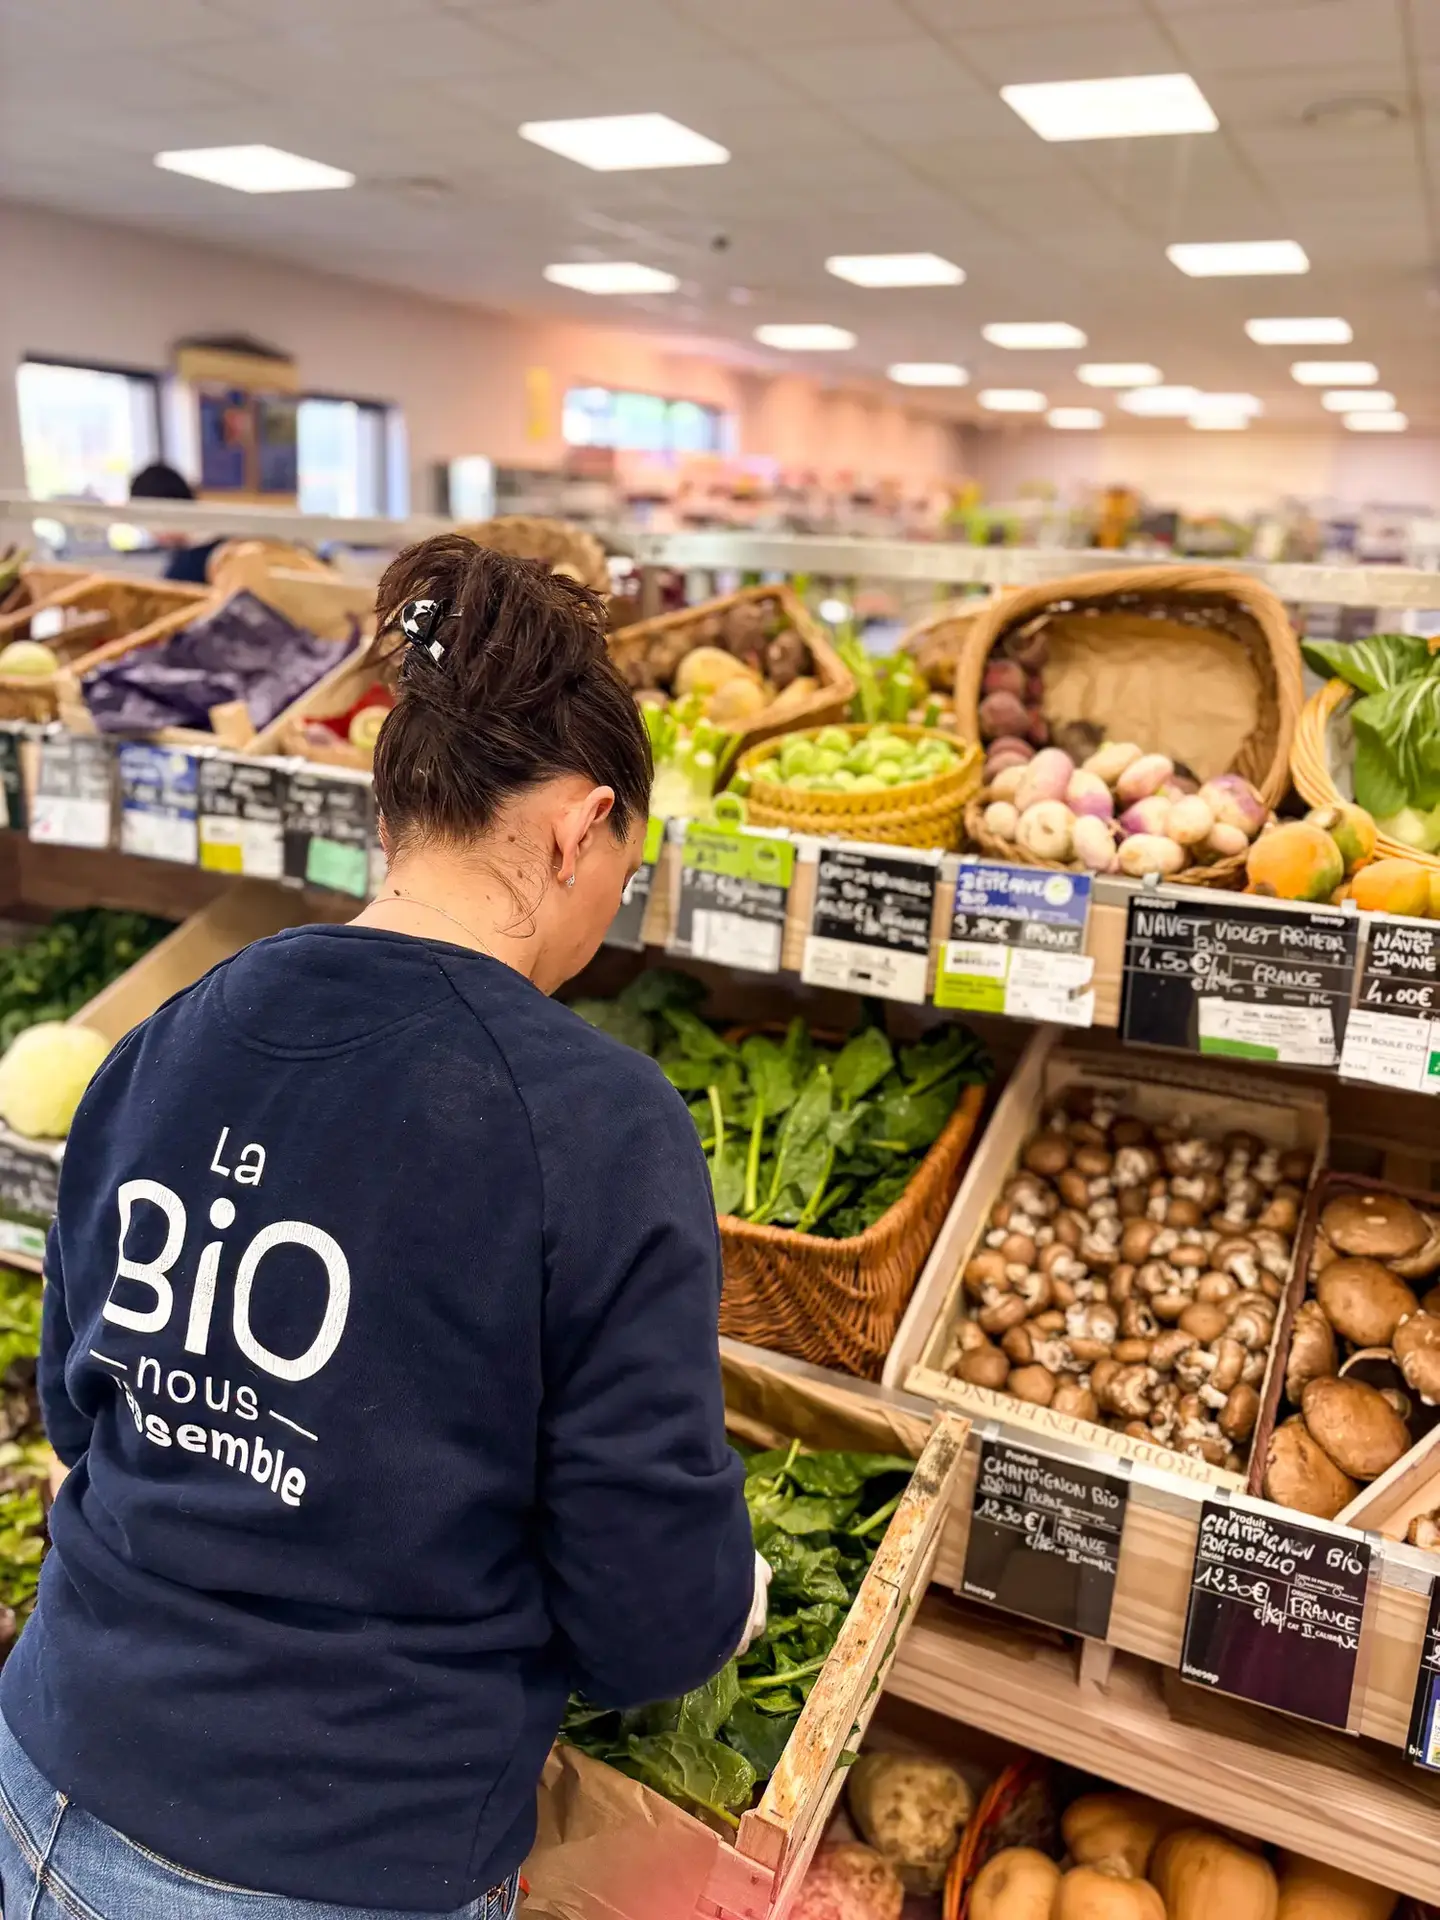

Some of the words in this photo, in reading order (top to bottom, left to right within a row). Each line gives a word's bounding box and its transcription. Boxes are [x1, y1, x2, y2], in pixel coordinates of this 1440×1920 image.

[1136, 913, 1212, 938] NAVET
[1215, 921, 1279, 945] VIOLET
[1374, 932, 1434, 954] NAVET
[1252, 963, 1322, 987] FRANCE
[1372, 951, 1436, 972] JAUNE
[210, 1127, 266, 1186] La
[137, 1356, 258, 1421] nous
[1045, 1413, 1080, 1439] EN
[1090, 1425, 1212, 1482] PRODUIT
[1229, 1509, 1267, 1530] Produit
[1202, 1533, 1296, 1576] PORTOBELLO
[1290, 1597, 1361, 1632] FRANCE
